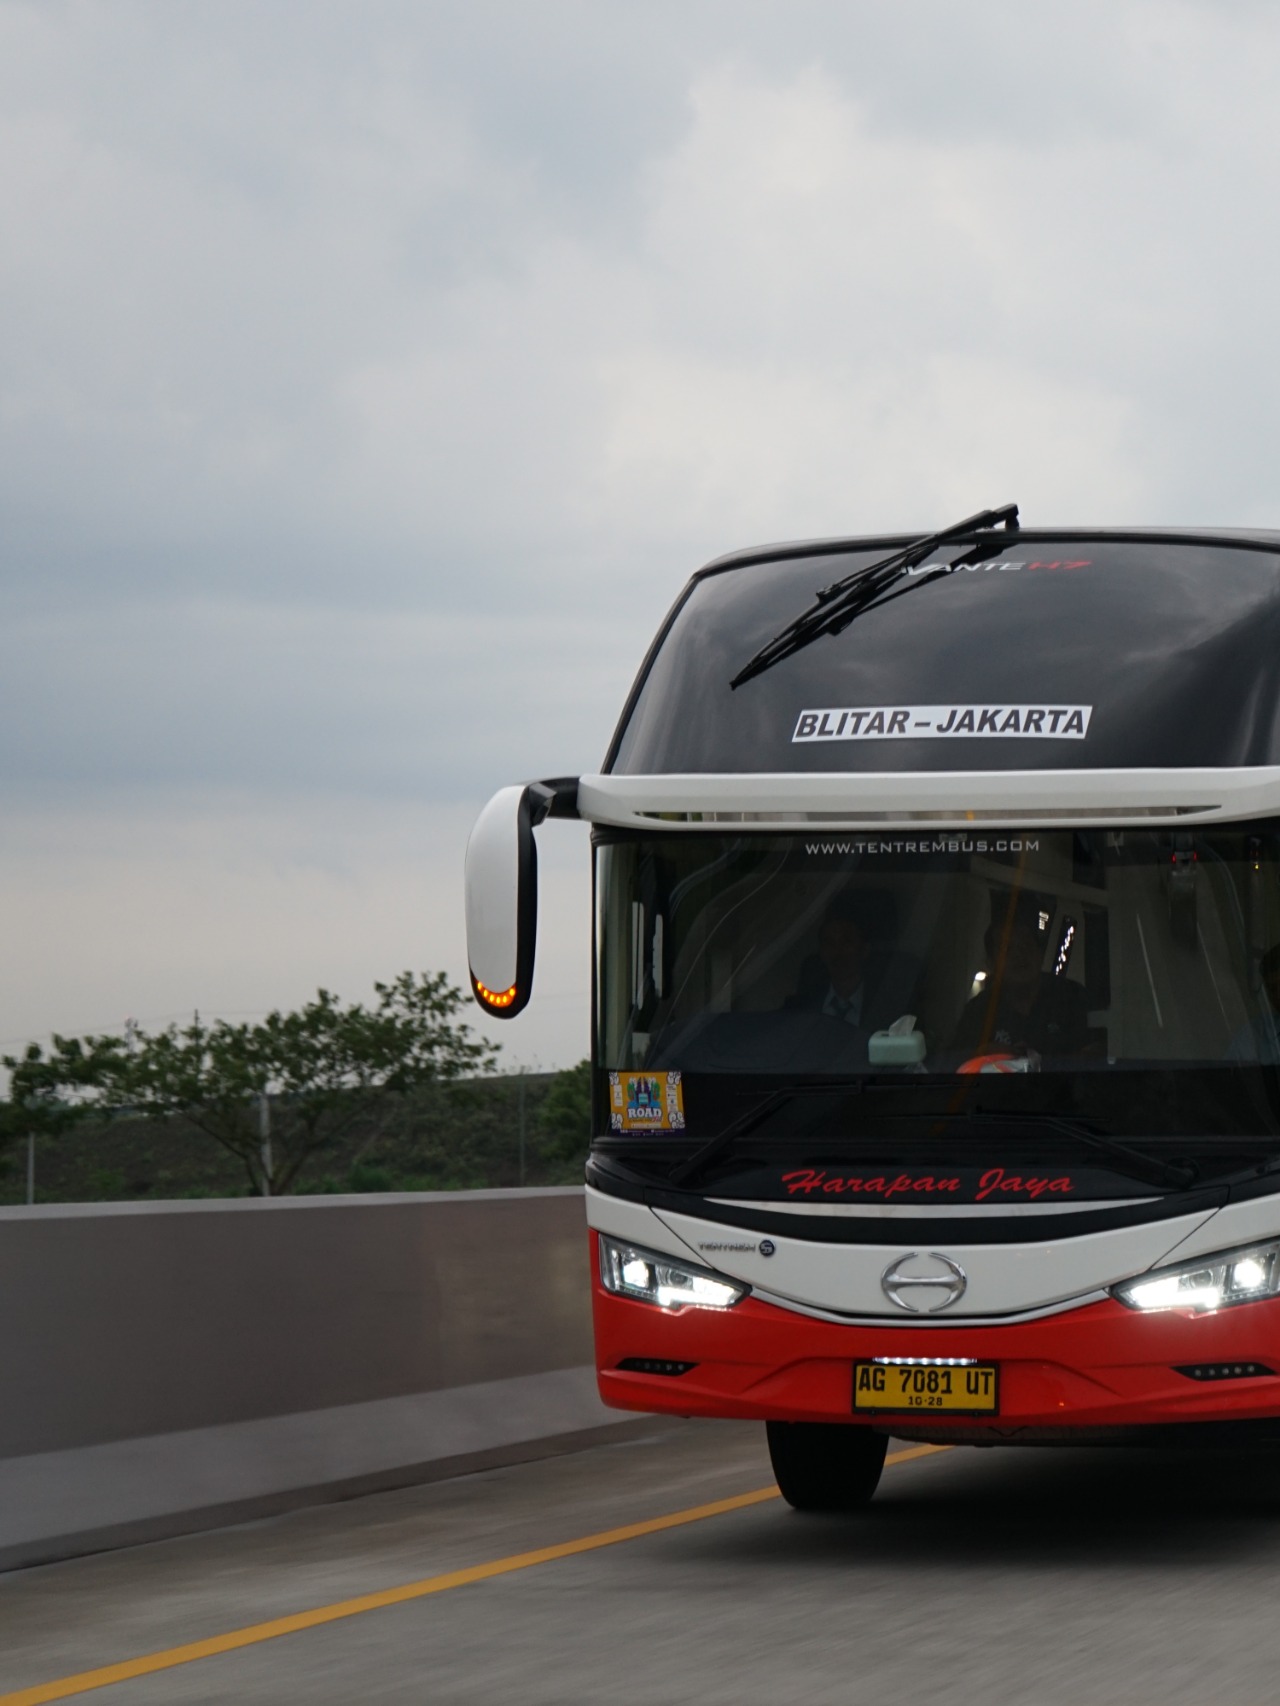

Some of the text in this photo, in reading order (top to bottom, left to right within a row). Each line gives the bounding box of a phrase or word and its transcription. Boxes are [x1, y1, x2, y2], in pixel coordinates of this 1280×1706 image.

[805, 841, 1040, 855] WWW.TENTREMBUS.COM
[627, 1108, 663, 1118] ROAD
[782, 1168, 1075, 1200] Harapan Jaya
[858, 1368, 993, 1395] AG 7081 UT
